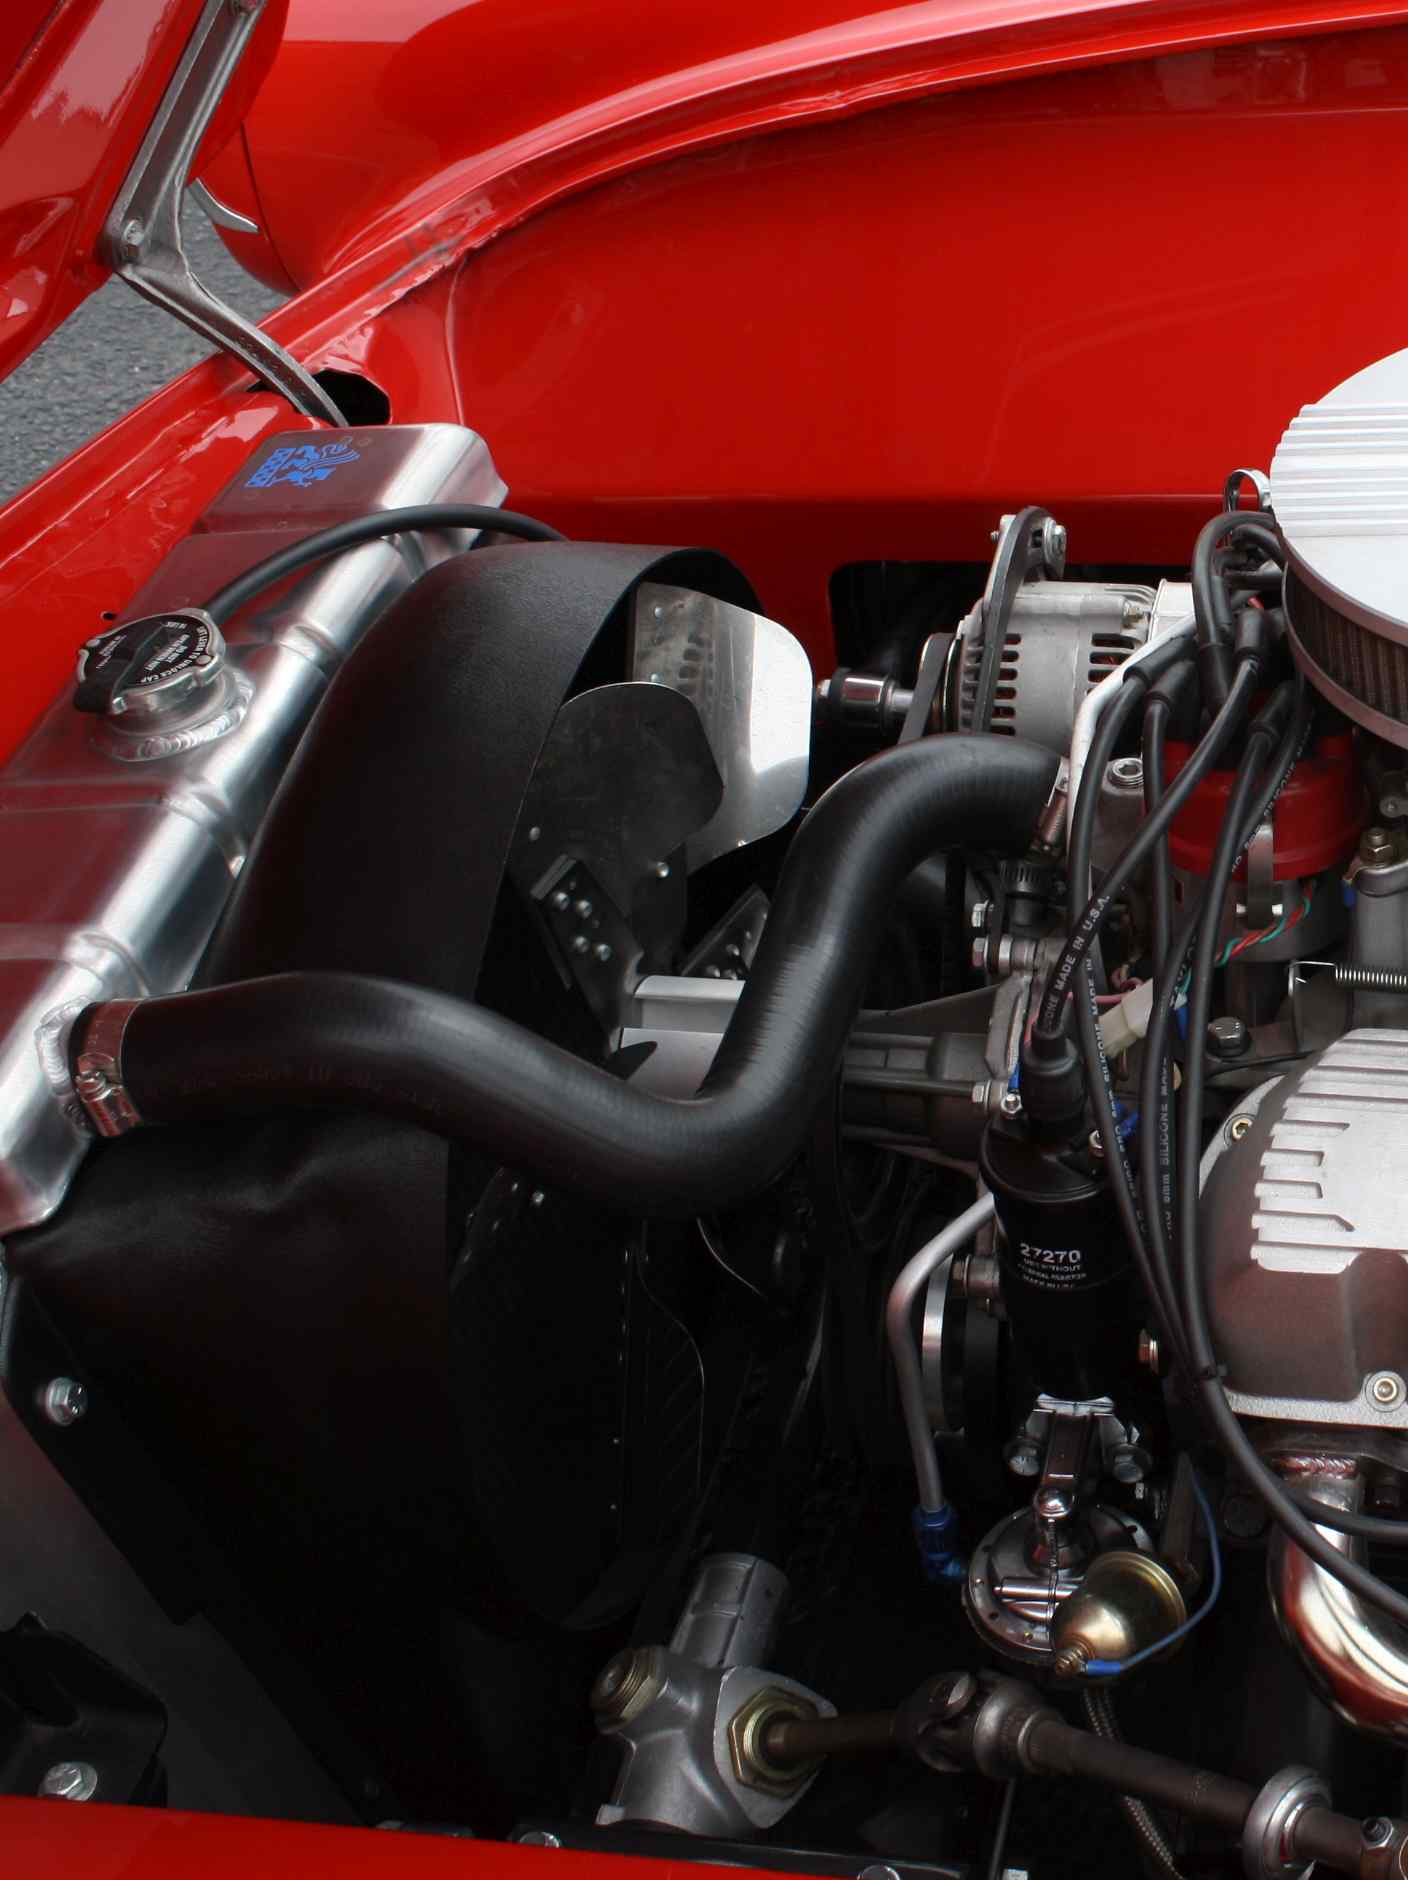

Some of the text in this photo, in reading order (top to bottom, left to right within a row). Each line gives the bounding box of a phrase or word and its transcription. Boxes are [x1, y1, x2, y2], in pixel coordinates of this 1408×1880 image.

[1054, 895, 1110, 990] MADE IN U.S.A.
[1019, 1242, 1081, 1263] 27270
